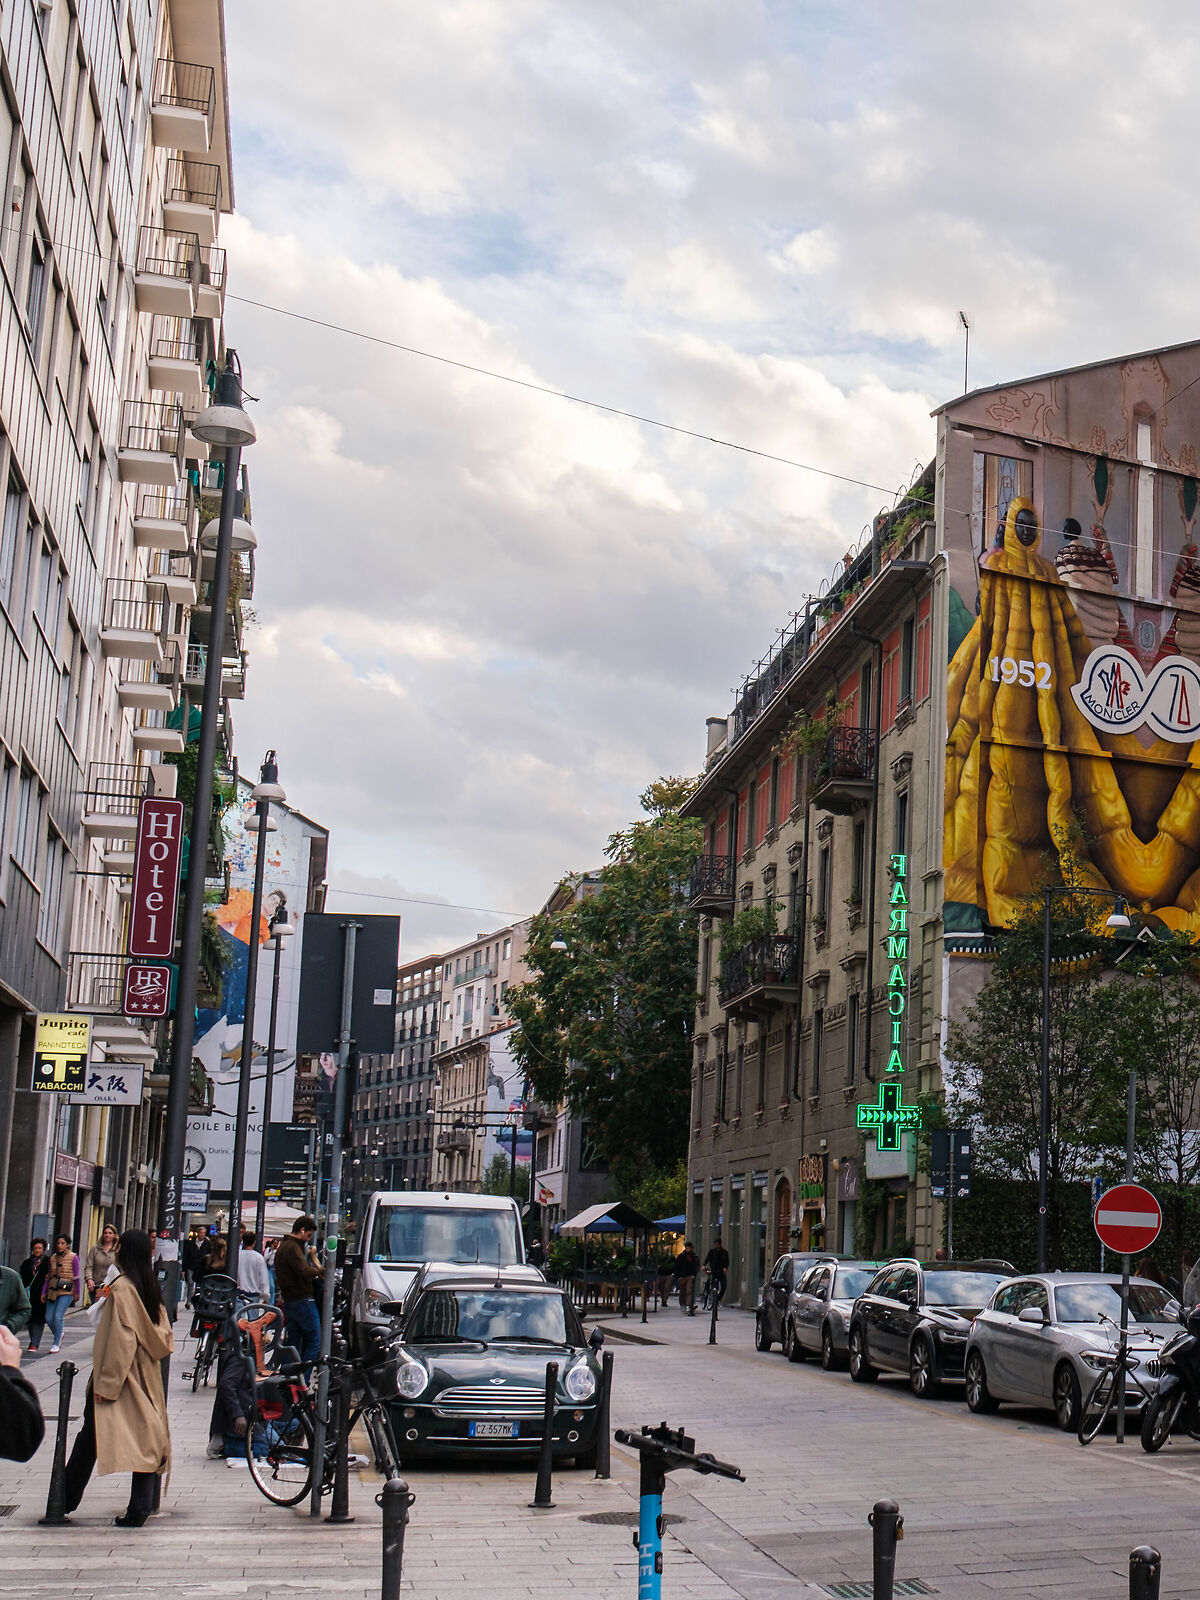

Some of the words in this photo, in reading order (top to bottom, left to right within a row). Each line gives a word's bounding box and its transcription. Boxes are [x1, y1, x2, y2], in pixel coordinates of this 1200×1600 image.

[990, 656, 1052, 690] 1952
[1085, 694, 1140, 720] MONCLER
[146, 812, 176, 942] Hotel
[136, 970, 162, 986] HR
[40, 1019, 88, 1030] Jupito
[41, 1054, 81, 1082] T
[35, 1082, 83, 1090] TABACCHI
[88, 1073, 128, 1093] 大阪
[186, 1122, 219, 1130] VOILE
[225, 1124, 264, 1132] BLNC
[639, 1543, 653, 1600] HEL
